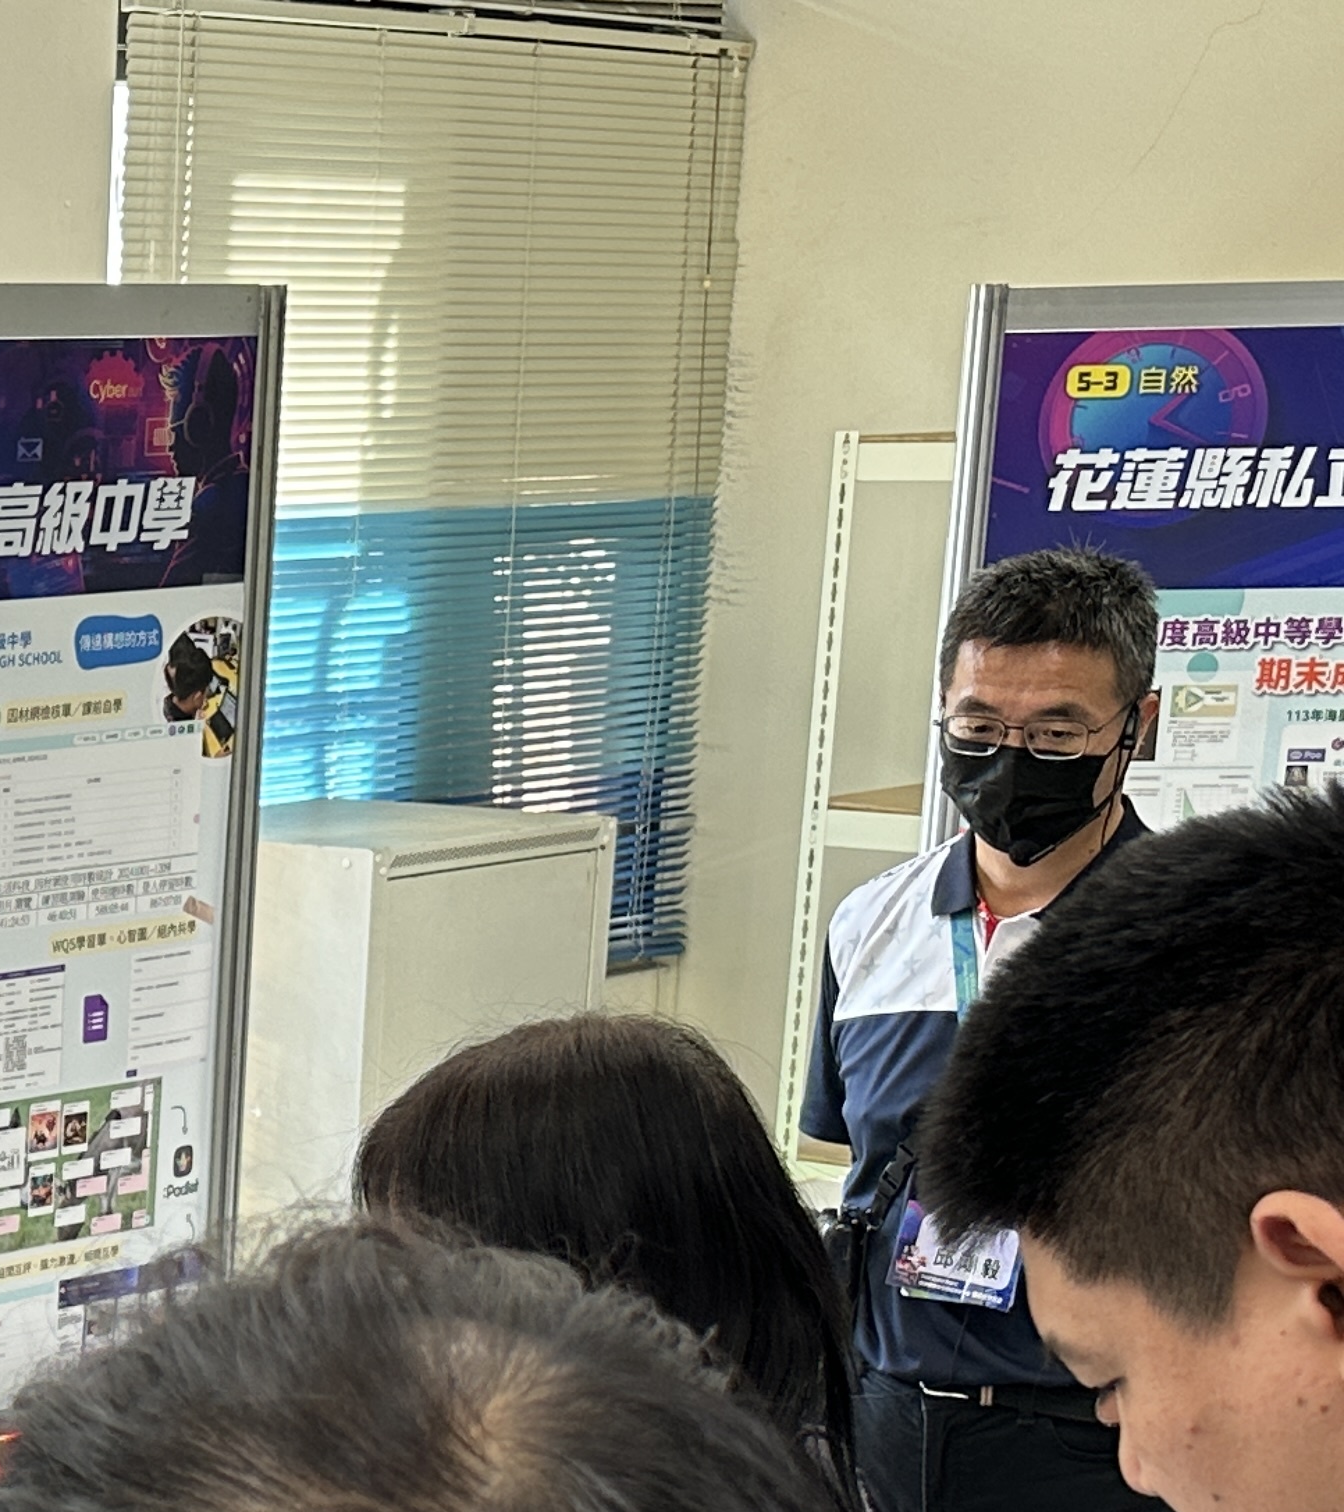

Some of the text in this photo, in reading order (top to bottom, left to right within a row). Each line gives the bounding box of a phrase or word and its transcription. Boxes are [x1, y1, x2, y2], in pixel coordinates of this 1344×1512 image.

[1077, 365, 1200, 395] 5-3 自然
[18, 651, 64, 668] SCHOOL
